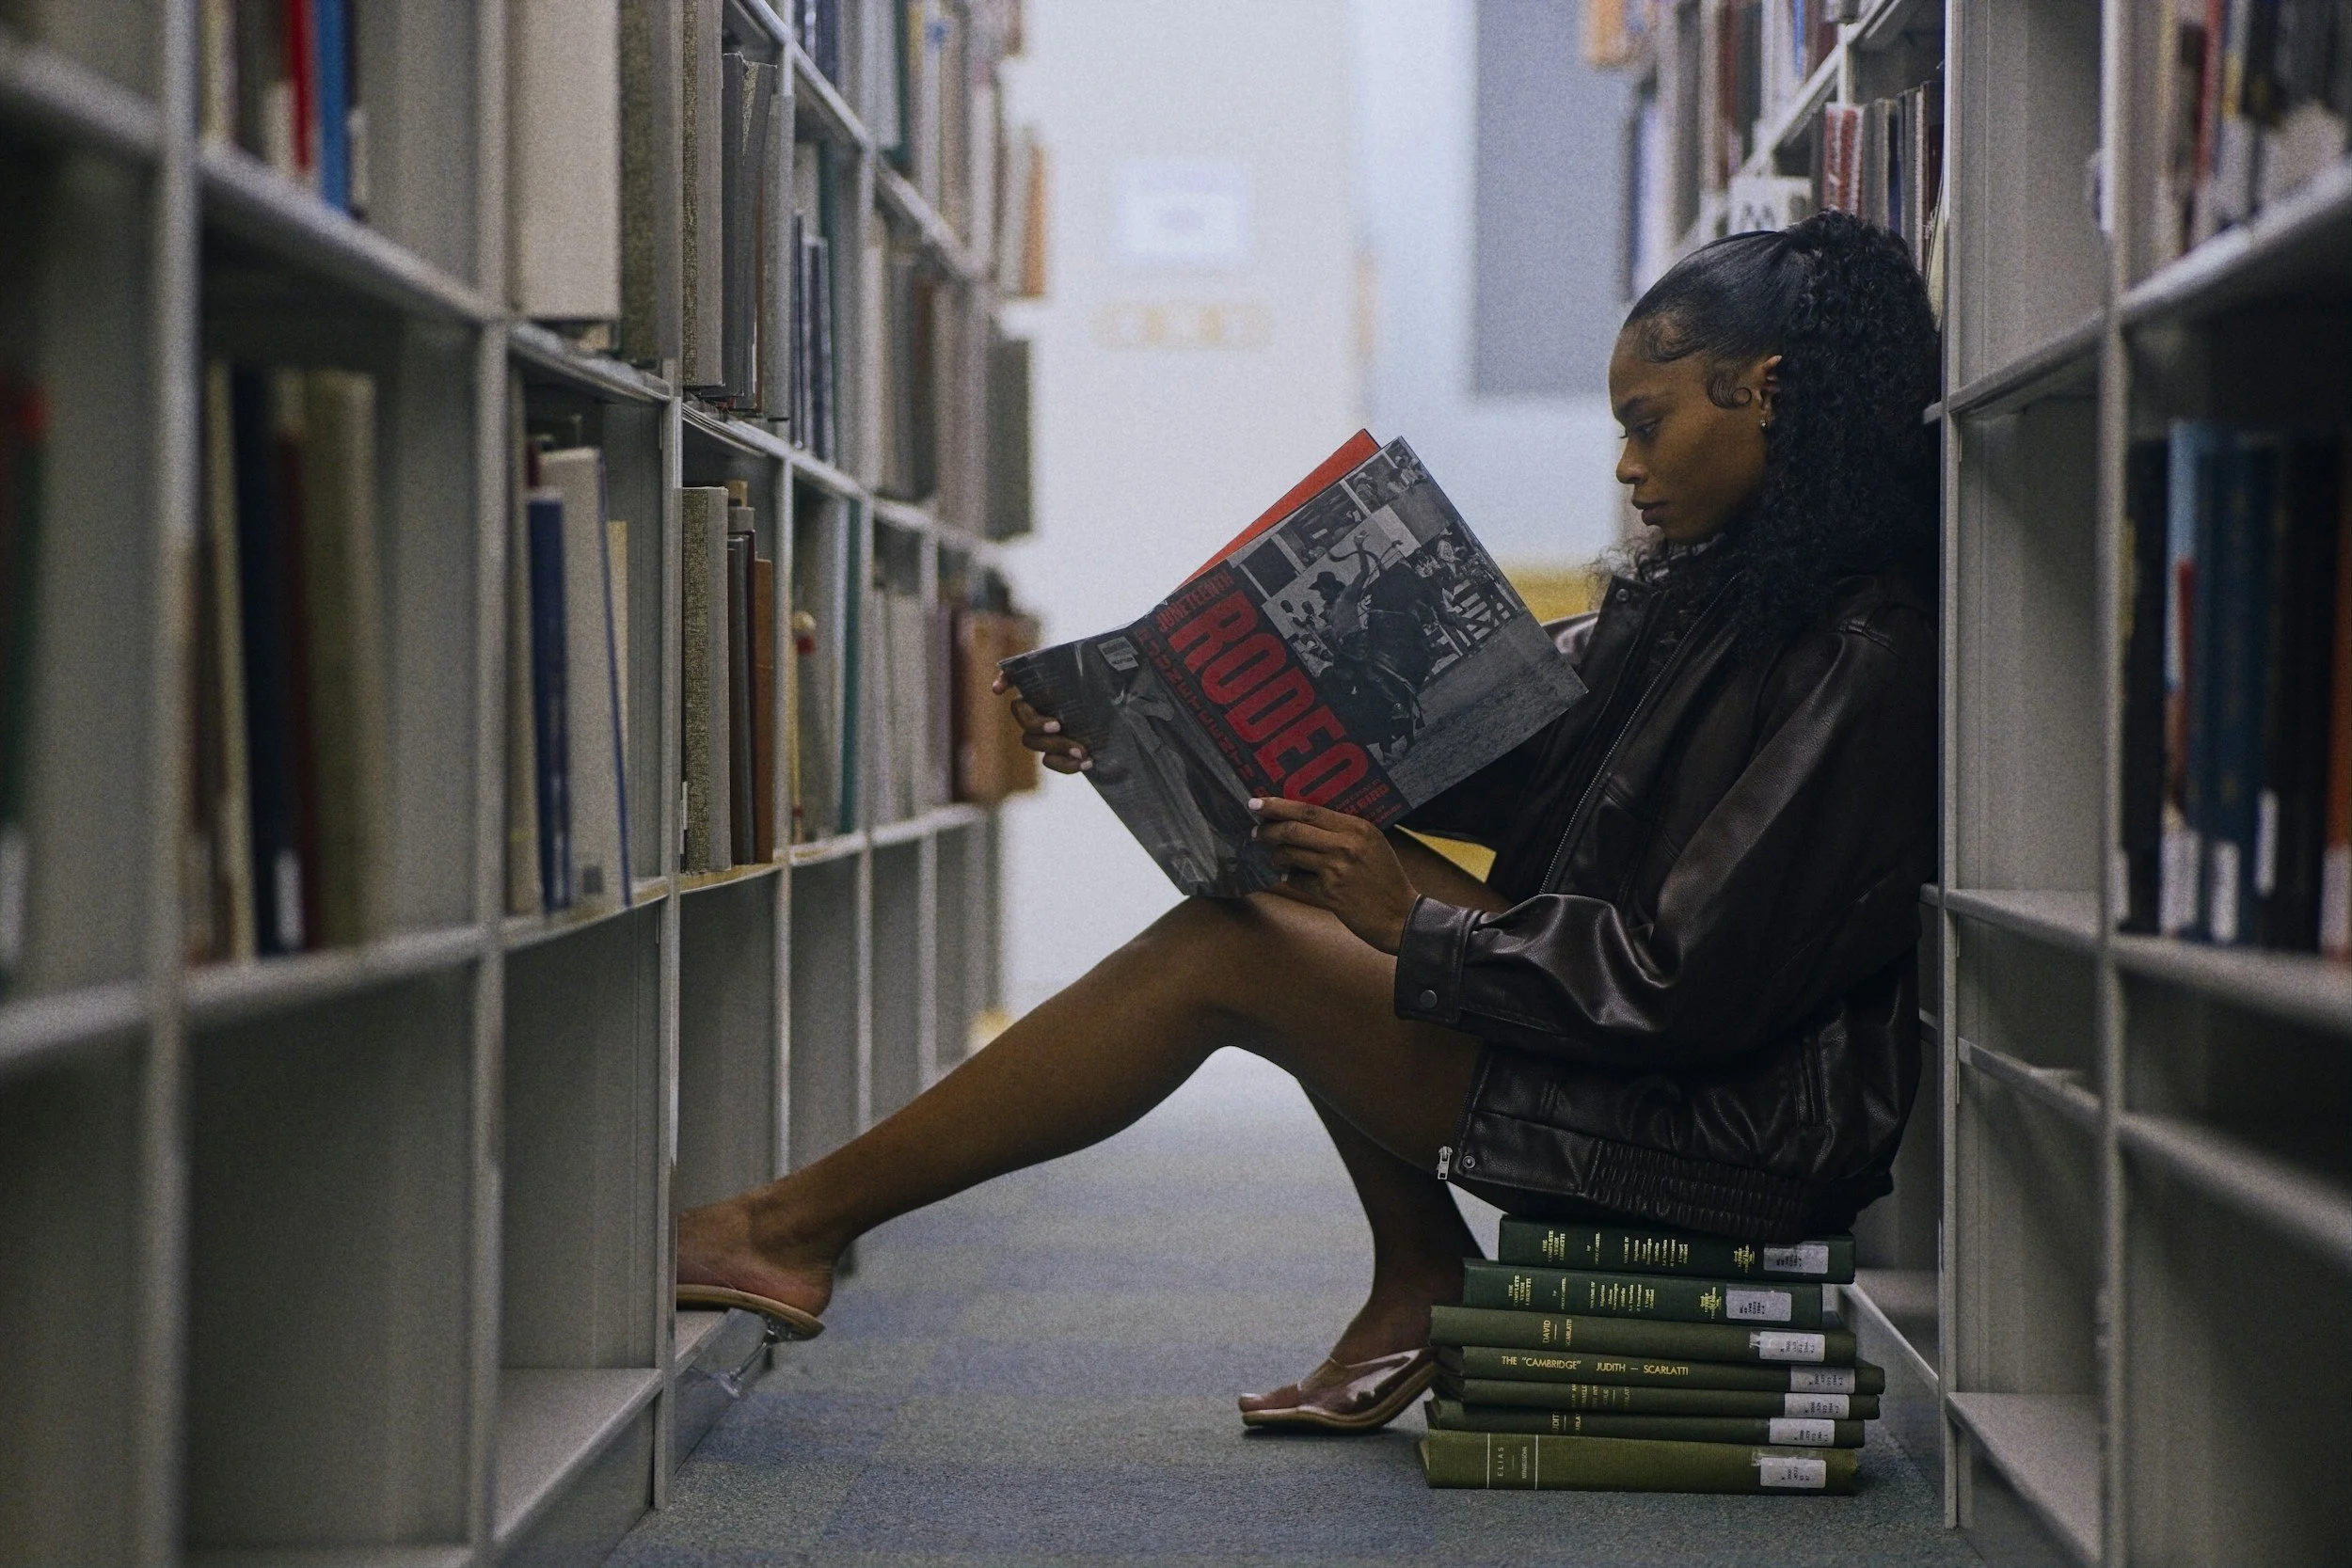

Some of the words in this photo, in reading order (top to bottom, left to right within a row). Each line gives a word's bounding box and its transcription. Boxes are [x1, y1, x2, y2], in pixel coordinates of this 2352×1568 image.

[1167, 589, 1369, 806] RODEO
[1355, 782, 1391, 810] BIRD
[1542, 1320, 1550, 1343] DAVID
[1502, 1355, 1518, 1365] THE
[1521, 1357, 1581, 1370] "CAMBRIDGE"
[1596, 1362, 1626, 1372] JUDITH
[1644, 1364, 1689, 1376] SCARLATTI
[1551, 1414, 1560, 1432] UDIT
